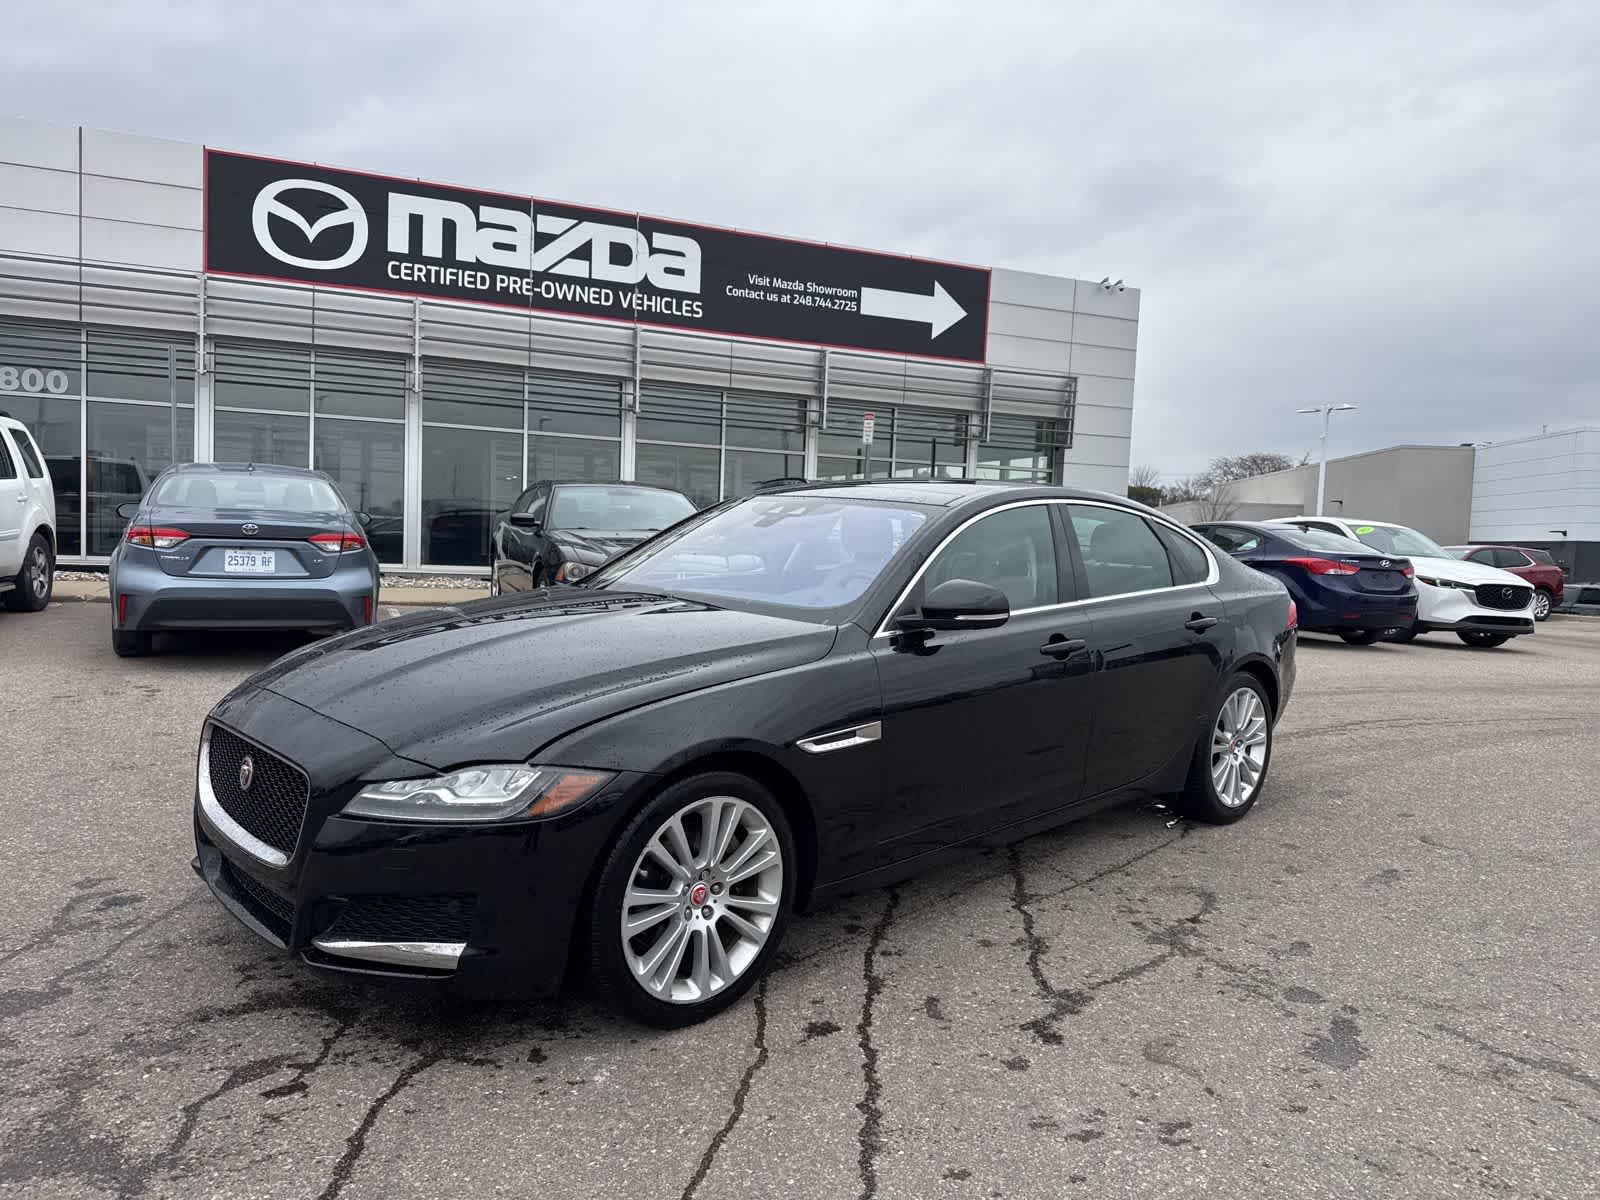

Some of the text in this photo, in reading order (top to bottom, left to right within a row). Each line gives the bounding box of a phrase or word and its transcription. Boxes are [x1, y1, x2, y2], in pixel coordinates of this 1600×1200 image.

[387, 261, 703, 318] CERTIFIED PRE-OWNED VEHICLES
[748, 274, 857, 298] Visit Mazda Showroom
[726, 286, 857, 312] Contact us at 248.744.2725
[228, 555, 256, 566] 25379
